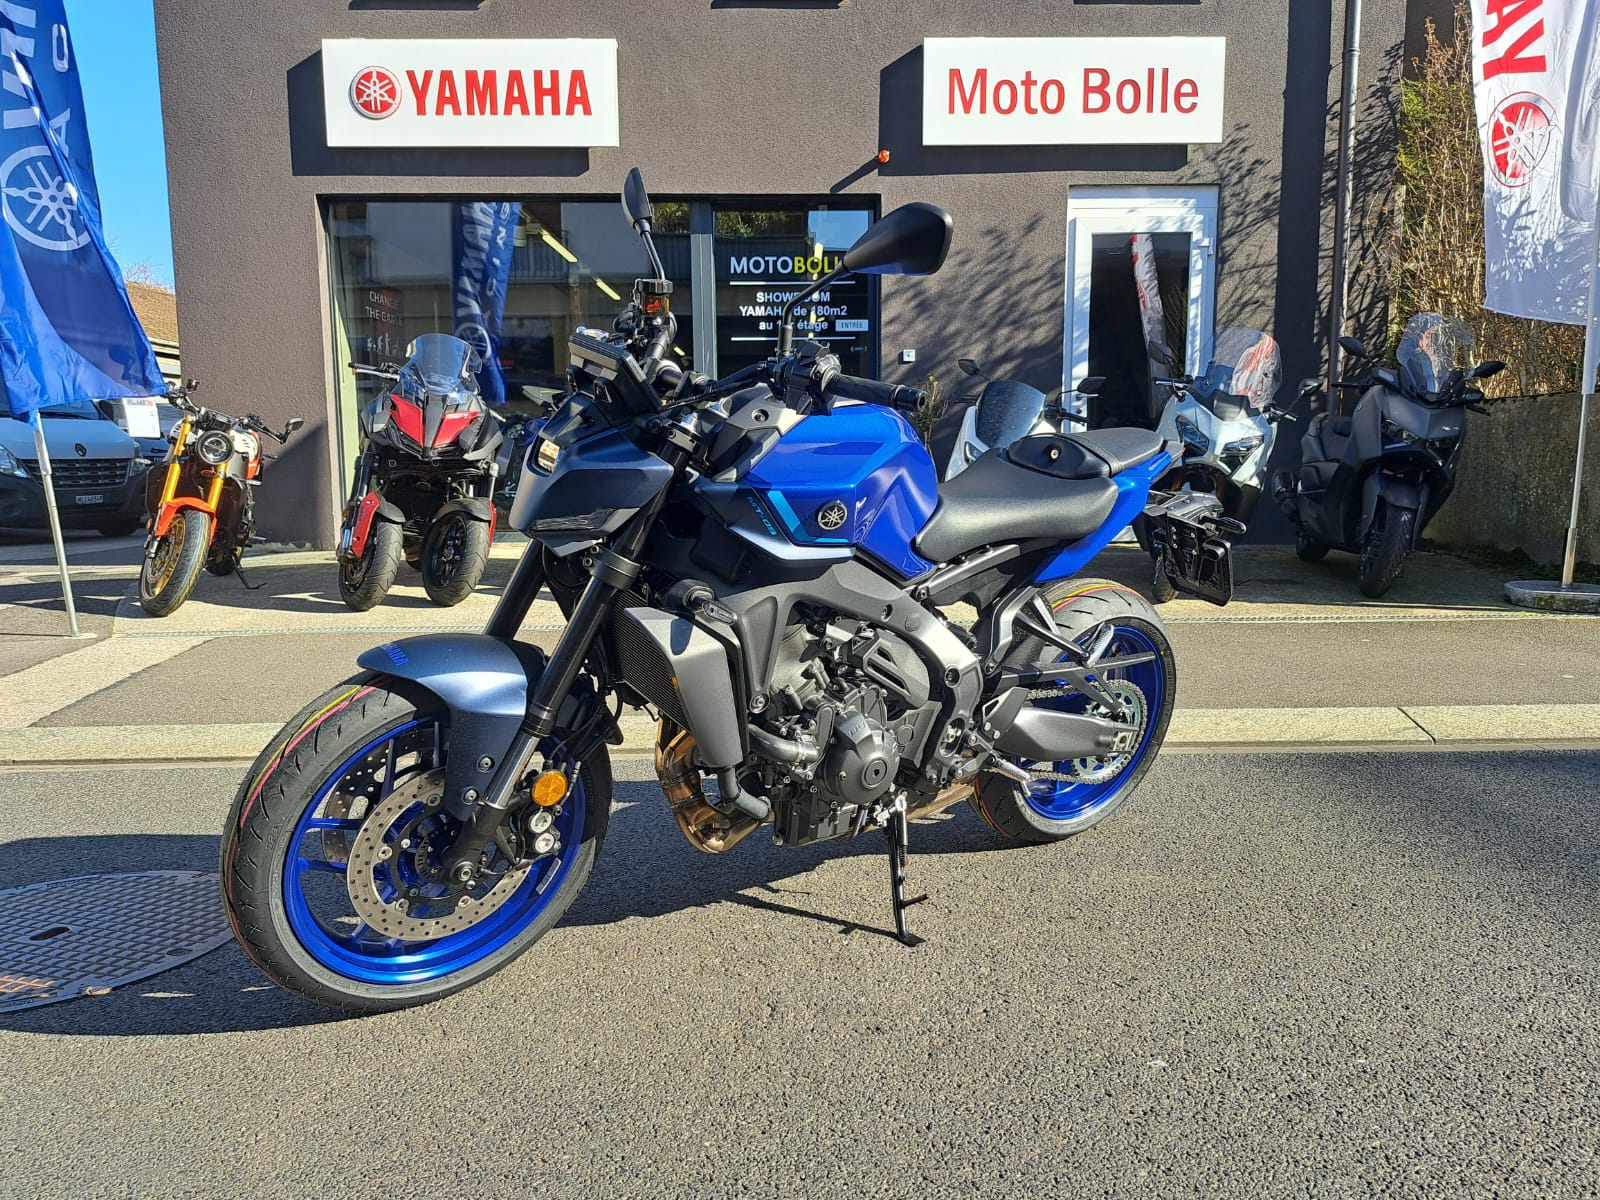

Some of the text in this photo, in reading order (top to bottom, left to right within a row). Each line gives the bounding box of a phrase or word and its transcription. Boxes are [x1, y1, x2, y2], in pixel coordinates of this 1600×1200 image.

[405, 69, 593, 116] YAMAHA
[948, 67, 1199, 115] Moto Bolle
[365, 305, 380, 320] THE
[739, 305, 786, 317] YAMAH
[793, 305, 807, 316] de
[759, 321, 773, 330] au
[797, 319, 828, 332] étage
[746, 496, 777, 536] MT-09
